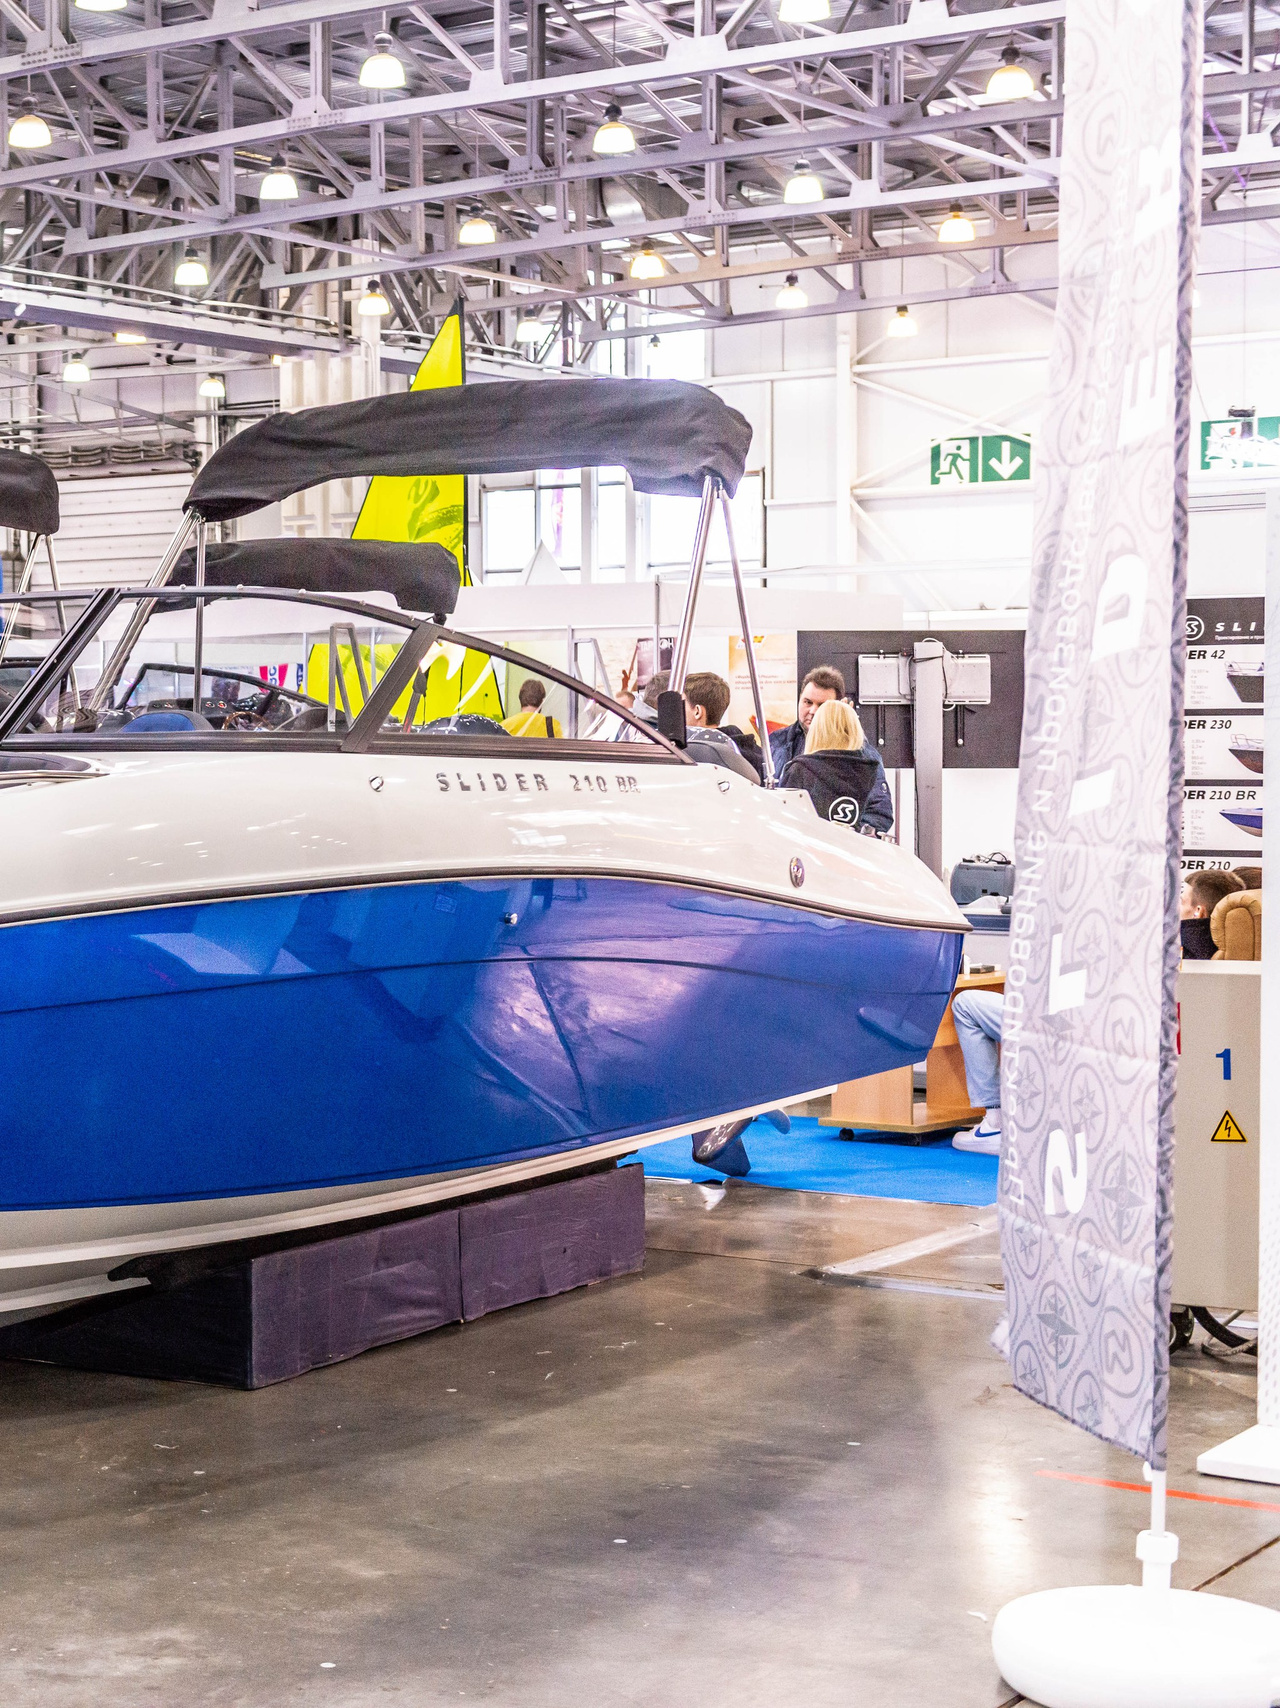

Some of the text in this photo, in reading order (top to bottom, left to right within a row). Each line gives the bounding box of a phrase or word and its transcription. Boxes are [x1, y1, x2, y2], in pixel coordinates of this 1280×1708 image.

[1211, 650, 1225, 659] 42
[1210, 720, 1232, 729] 230
[436, 773, 641, 793] SLIDER 210 BR
[1209, 790, 1231, 800] 210
[1235, 790, 1257, 800] BR
[1209, 861, 1231, 871] 210
[1215, 1048, 1232, 1081] 1
